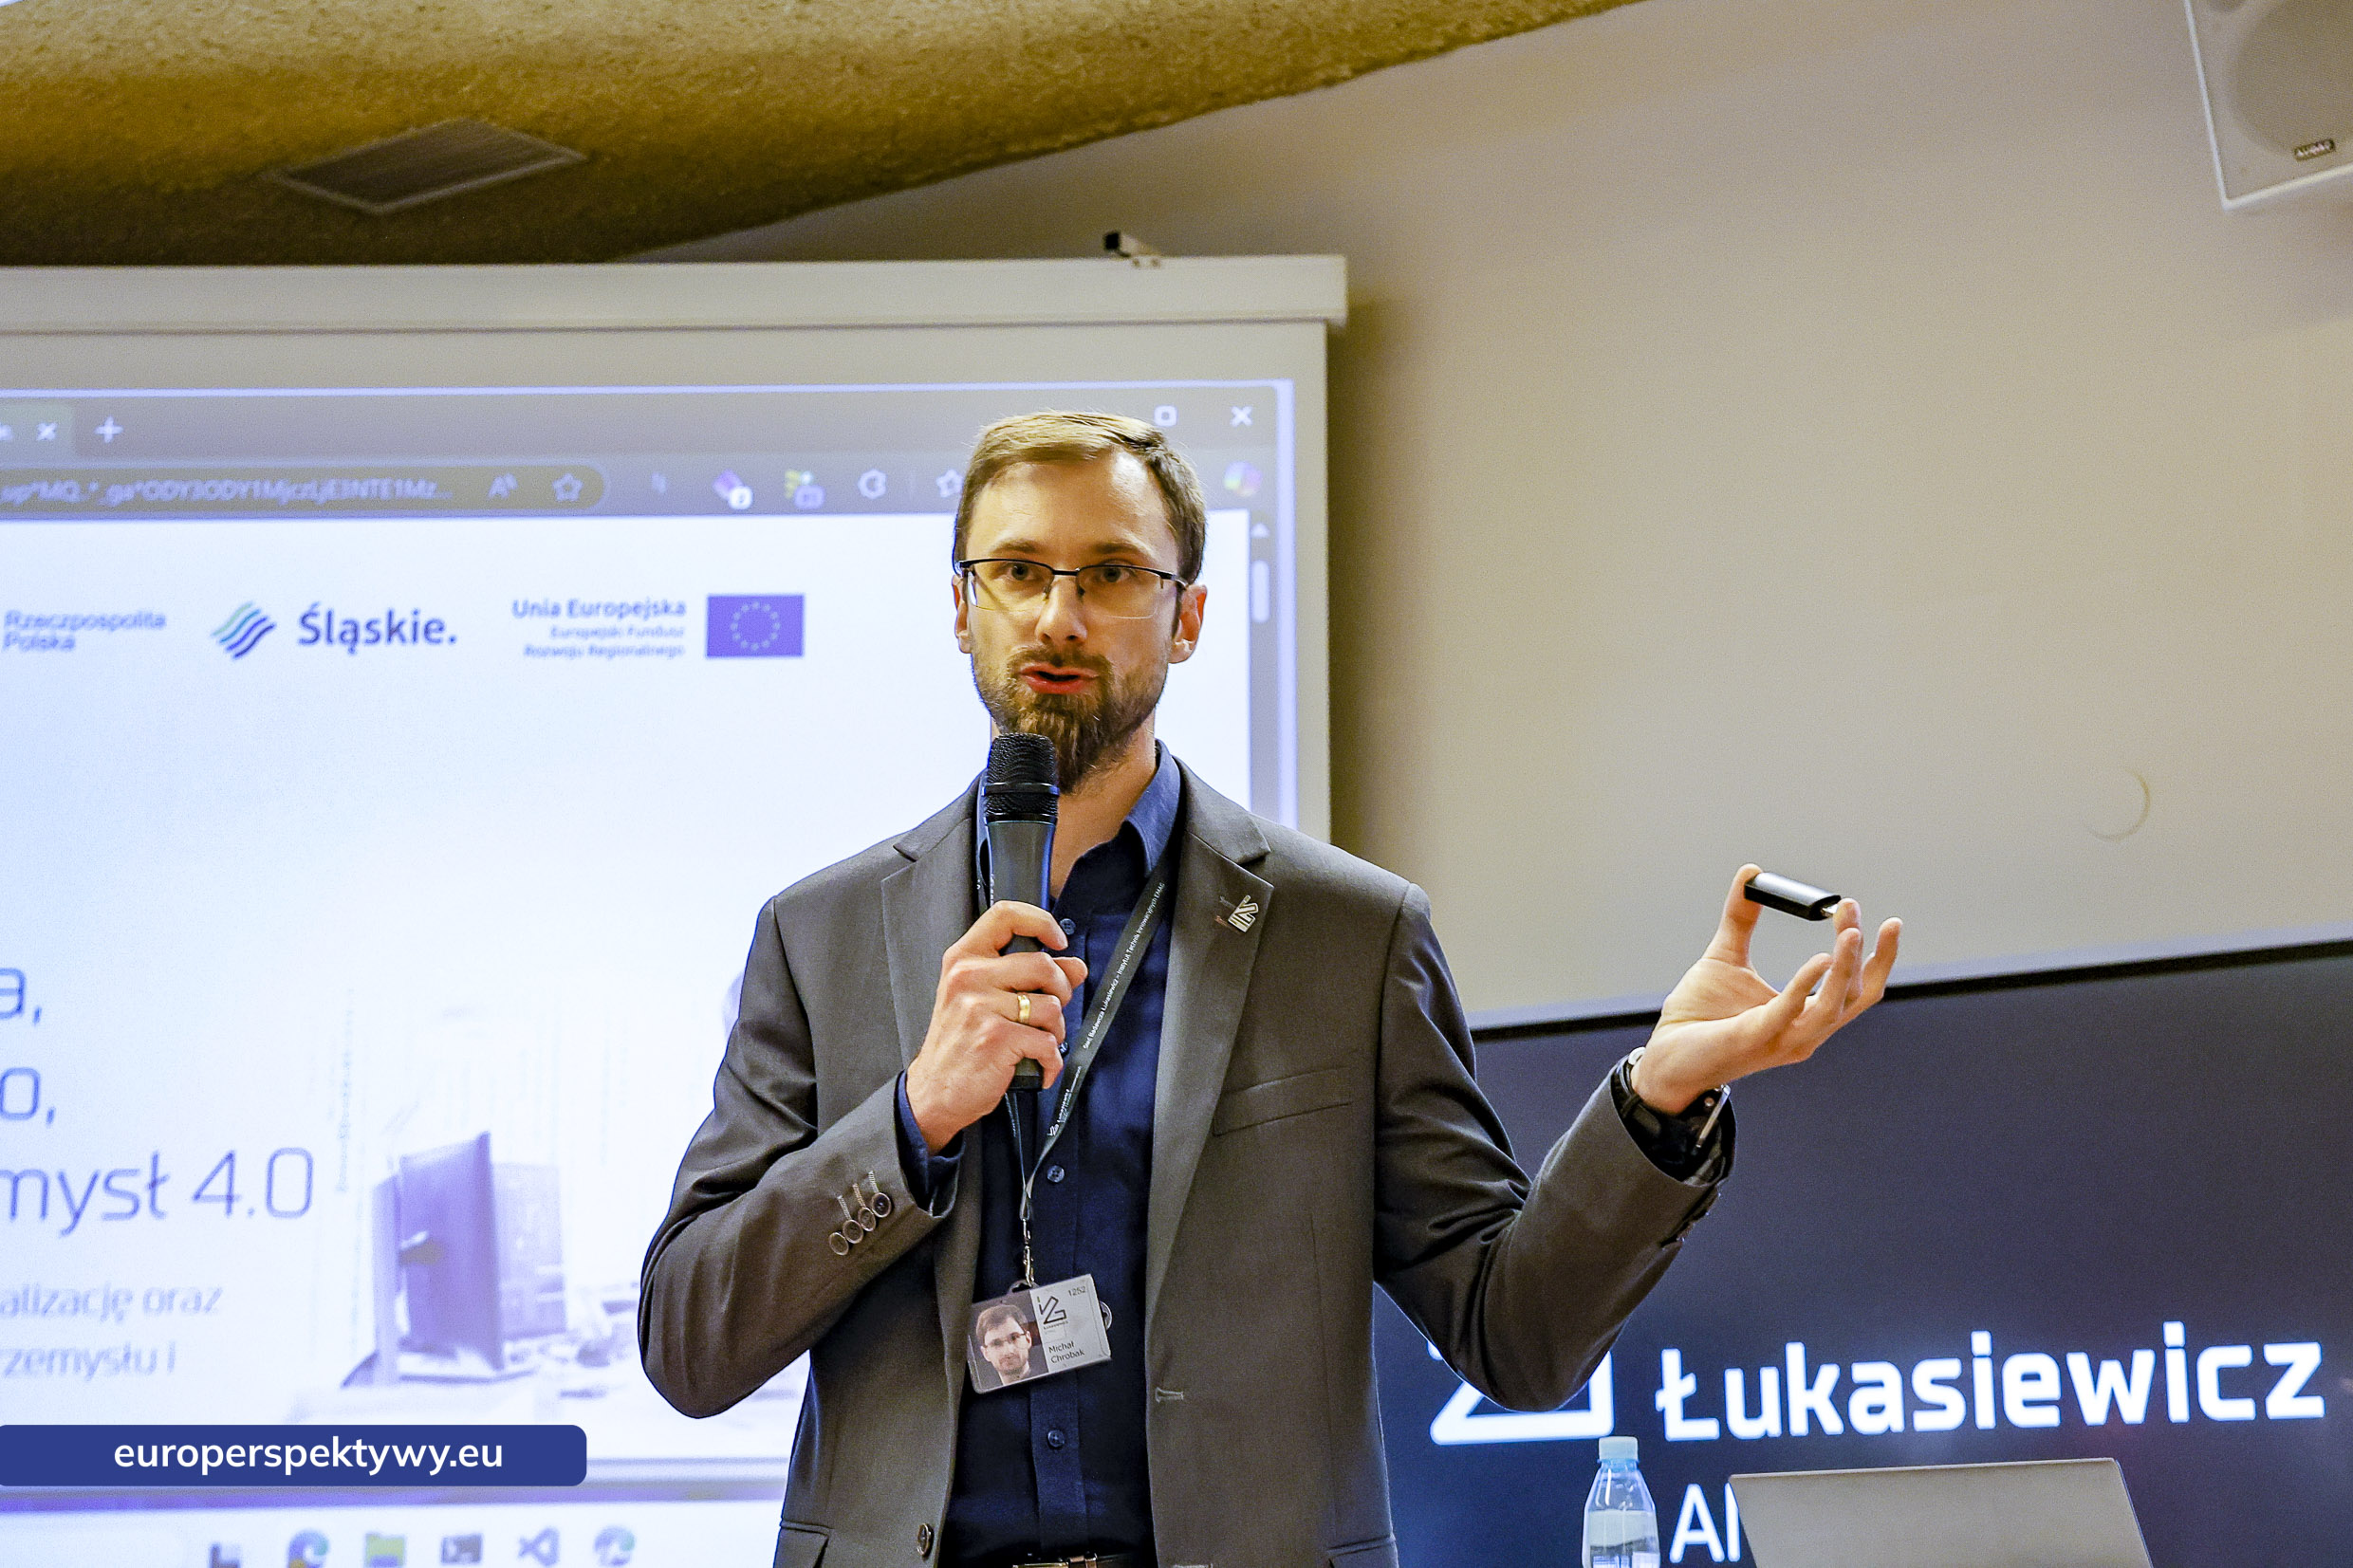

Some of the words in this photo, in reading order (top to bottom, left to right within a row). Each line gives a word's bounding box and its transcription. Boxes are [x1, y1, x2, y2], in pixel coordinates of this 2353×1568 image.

[4, 609, 167, 632] Rzeczpospolita
[511, 599, 562, 618] Unia
[567, 596, 687, 622] Europejska
[3, 631, 76, 652] Polska
[298, 601, 457, 655] Śląskie.
[191, 1146, 314, 1220] 4.0
[142, 1286, 224, 1317] oraz
[1050, 1349, 1085, 1364] Chrobak
[1655, 1319, 2325, 1442] Łukasiewicz
